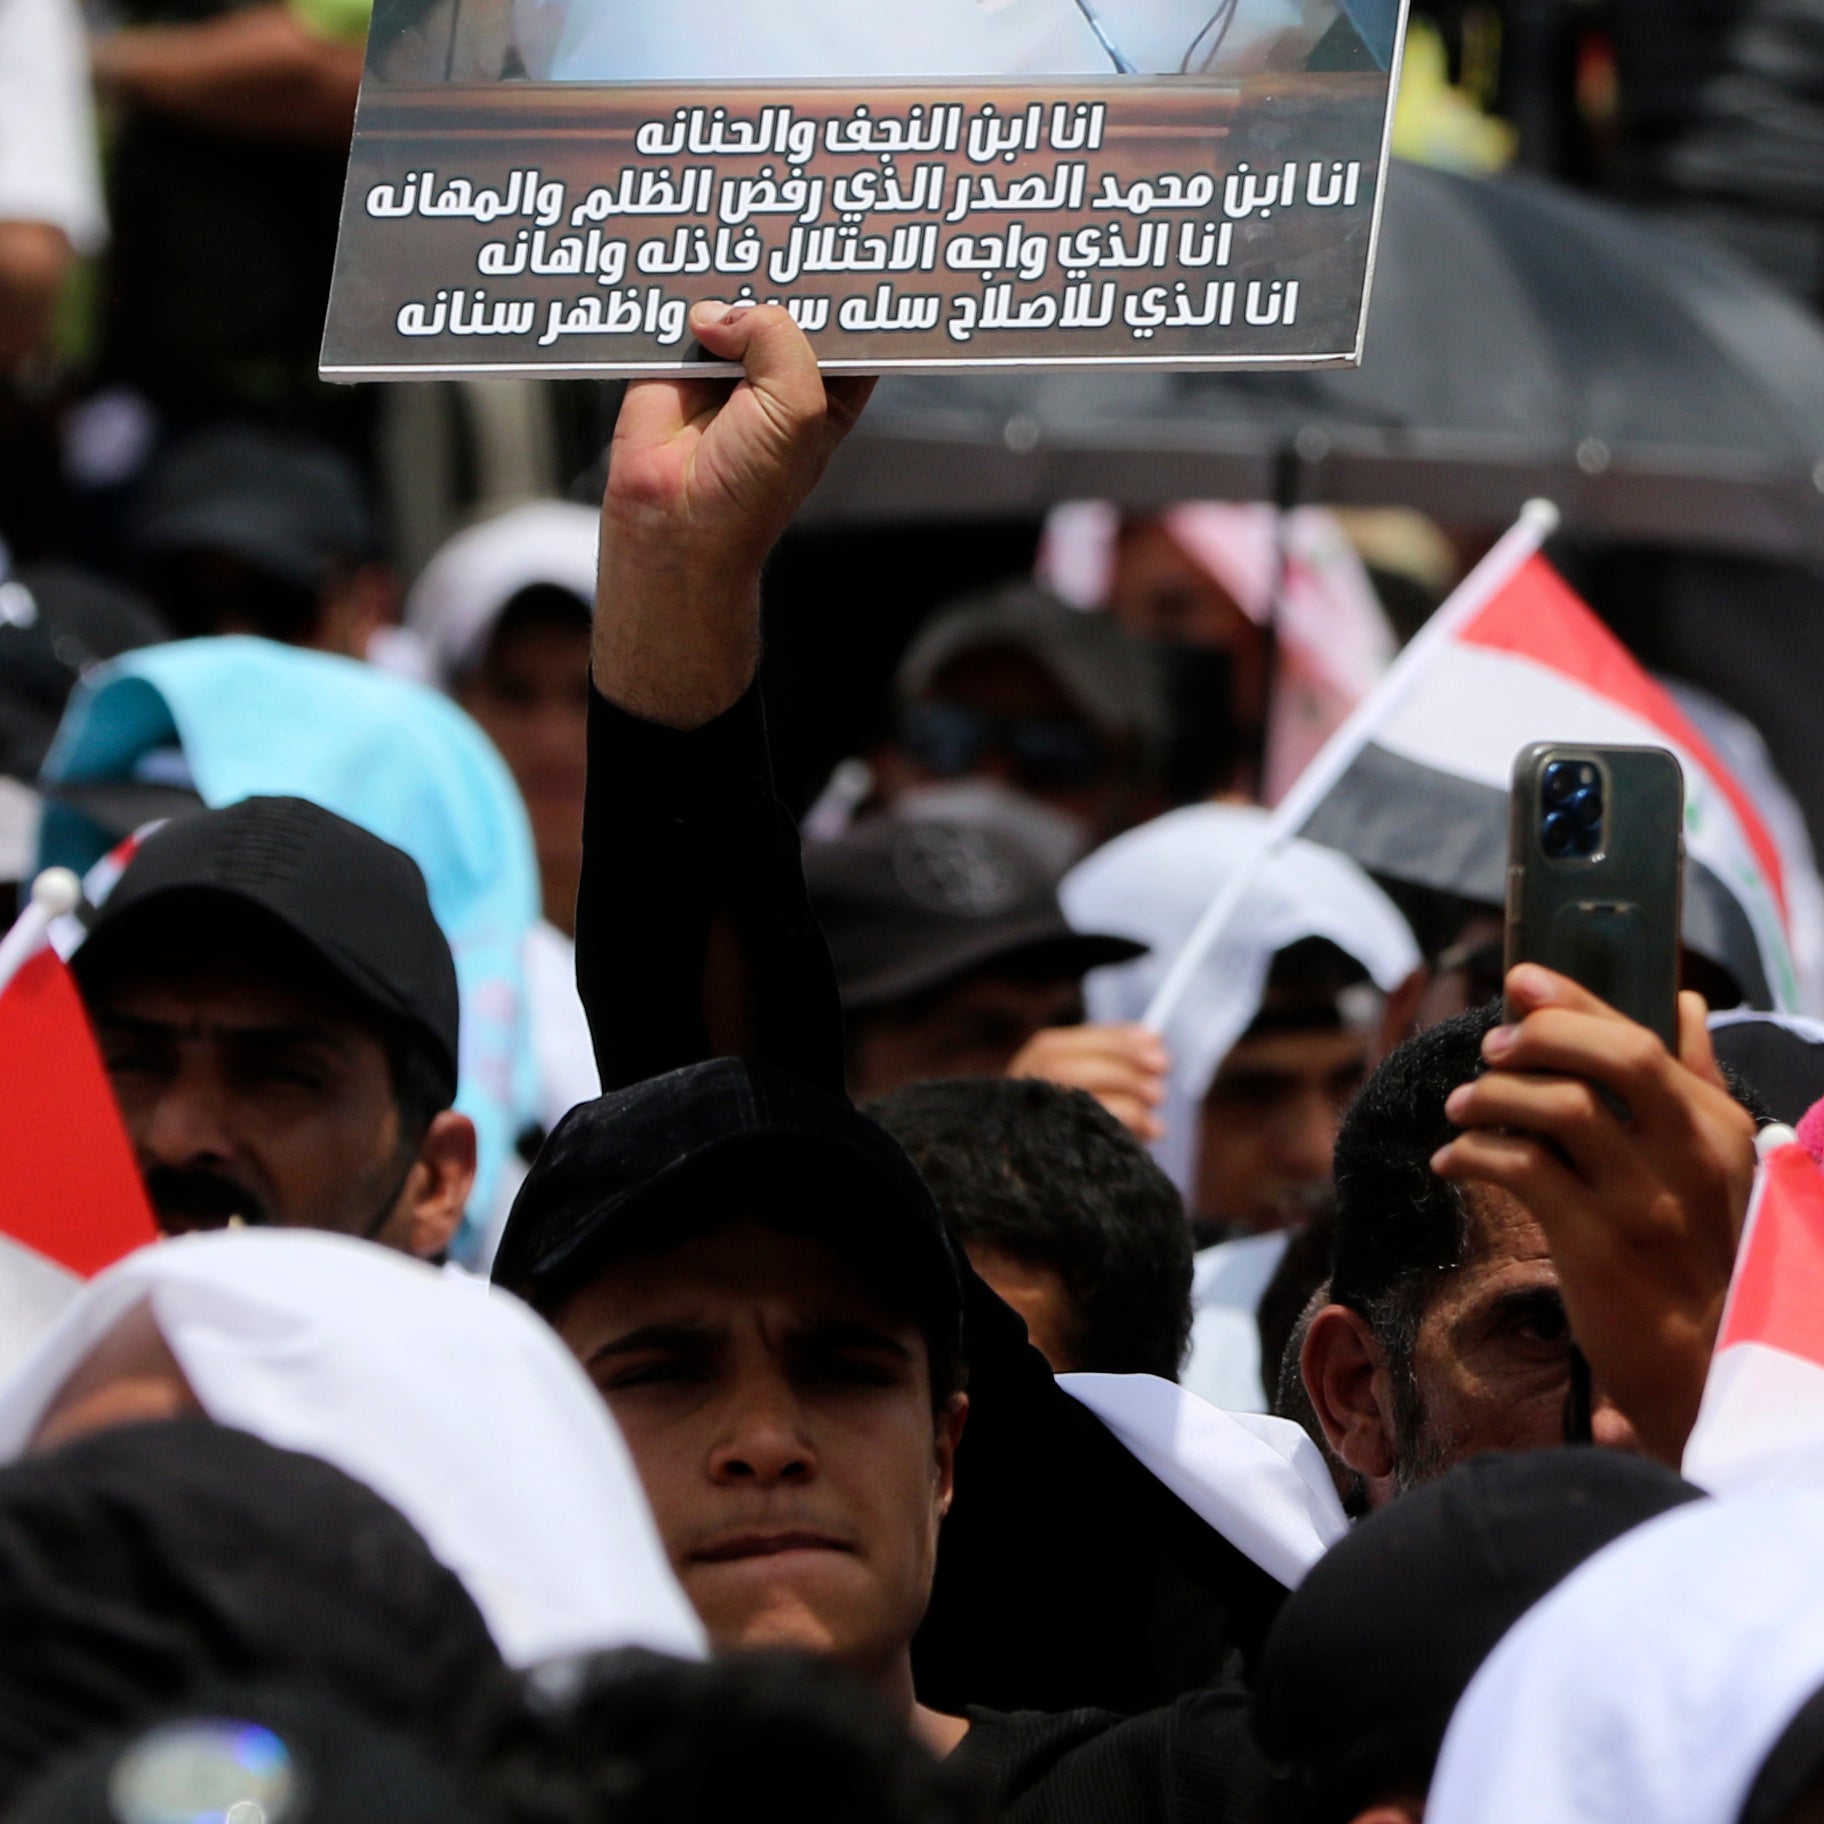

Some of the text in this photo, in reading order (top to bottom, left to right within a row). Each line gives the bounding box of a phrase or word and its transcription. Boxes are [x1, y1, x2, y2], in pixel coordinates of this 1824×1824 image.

[636, 104, 1105, 165] انا ابن النجف والحنانه
[366, 161, 1361, 227] انا ابن محمد الصدر الذي رفض الظلم والمهانه
[477, 221, 1234, 286] انا الذي واجه الاحتلال فاذله واهانه
[396, 290, 536, 336] سنانه
[537, 287, 687, 346] واظهر
[838, 285, 940, 331] سله
[948, 282, 1116, 341] للاصلاح
[1123, 281, 1236, 339] الذي
[1244, 280, 1300, 326] انا
